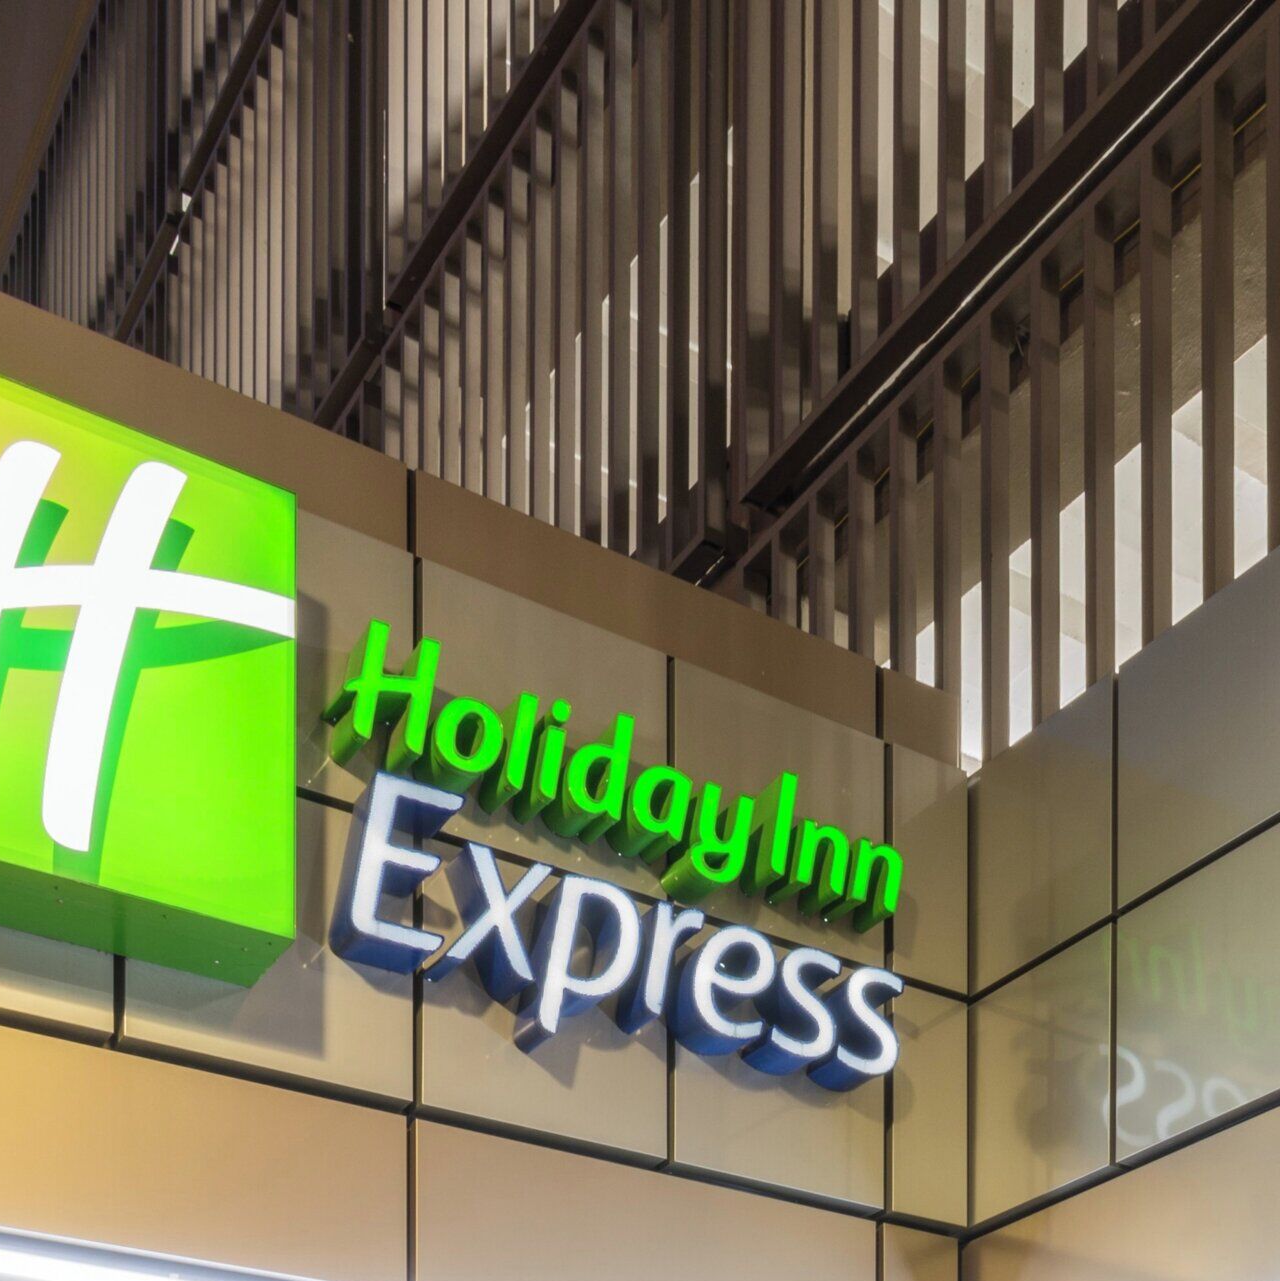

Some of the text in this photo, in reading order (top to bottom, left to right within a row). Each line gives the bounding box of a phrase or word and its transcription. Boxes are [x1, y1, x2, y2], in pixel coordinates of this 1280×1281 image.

[326, 619, 904, 922] Holiday Inn
[335, 770, 905, 1083] Express
